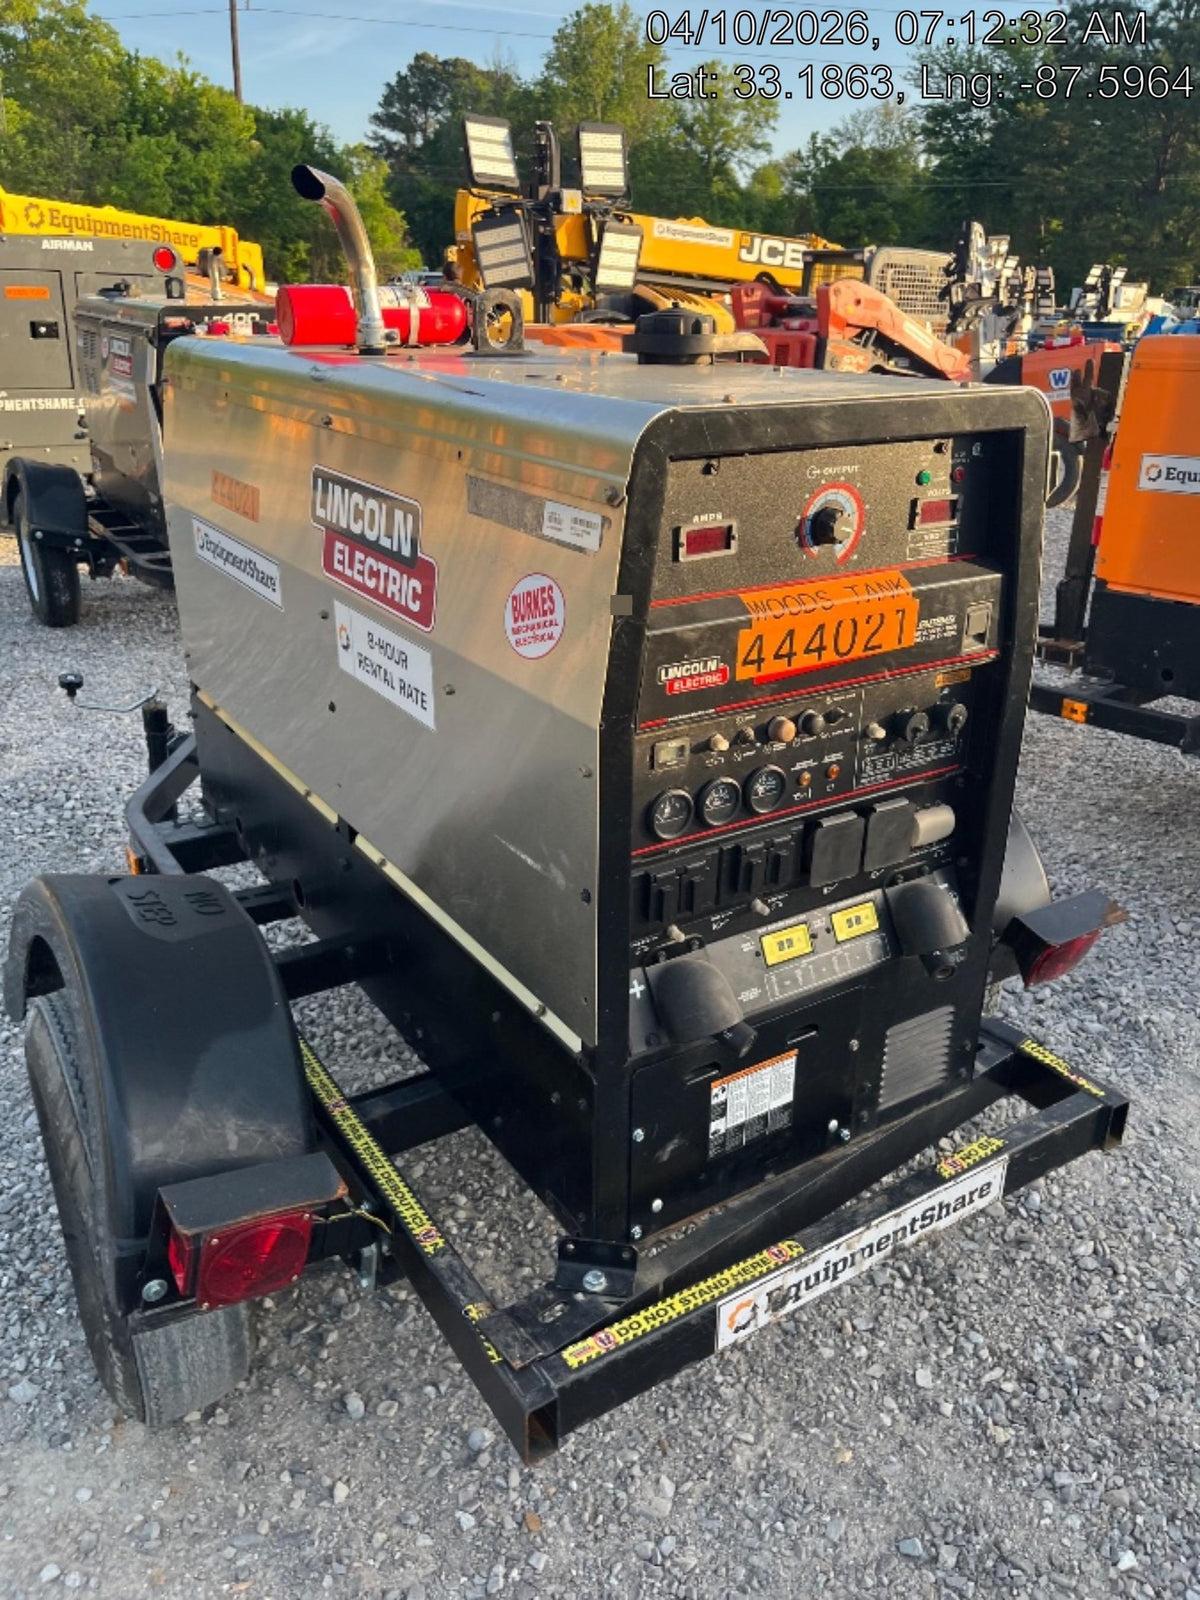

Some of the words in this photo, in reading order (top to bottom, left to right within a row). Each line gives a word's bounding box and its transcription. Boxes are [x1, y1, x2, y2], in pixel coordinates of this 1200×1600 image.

[41, 239, 94, 252] AIRMAN
[49, 208, 199, 248] EquipmentShare
[1051, 371, 1068, 387] W
[1165, 466, 1200, 484] Equ
[315, 477, 414, 558] LINCOLN
[333, 540, 422, 613] ELECTRIC
[511, 584, 556, 624] BURKES
[747, 589, 836, 621] WOODS
[844, 577, 911, 605] TANK
[366, 631, 409, 671] 8-HOUR
[740, 607, 906, 673] 444021
[356, 652, 396, 691] RENTAL
[399, 676, 428, 711] RATE
[660, 657, 718, 681] LINCOLN
[673, 671, 723, 690] ELECTRIC
[380, 1168, 416, 1213] DEBOUT
[765, 1180, 993, 1314] EquipmentShare
[616, 1320, 642, 1338] DO
[648, 1303, 678, 1324] NOT
[678, 1277, 731, 1306] STAND
[731, 1257, 771, 1283] HERE
